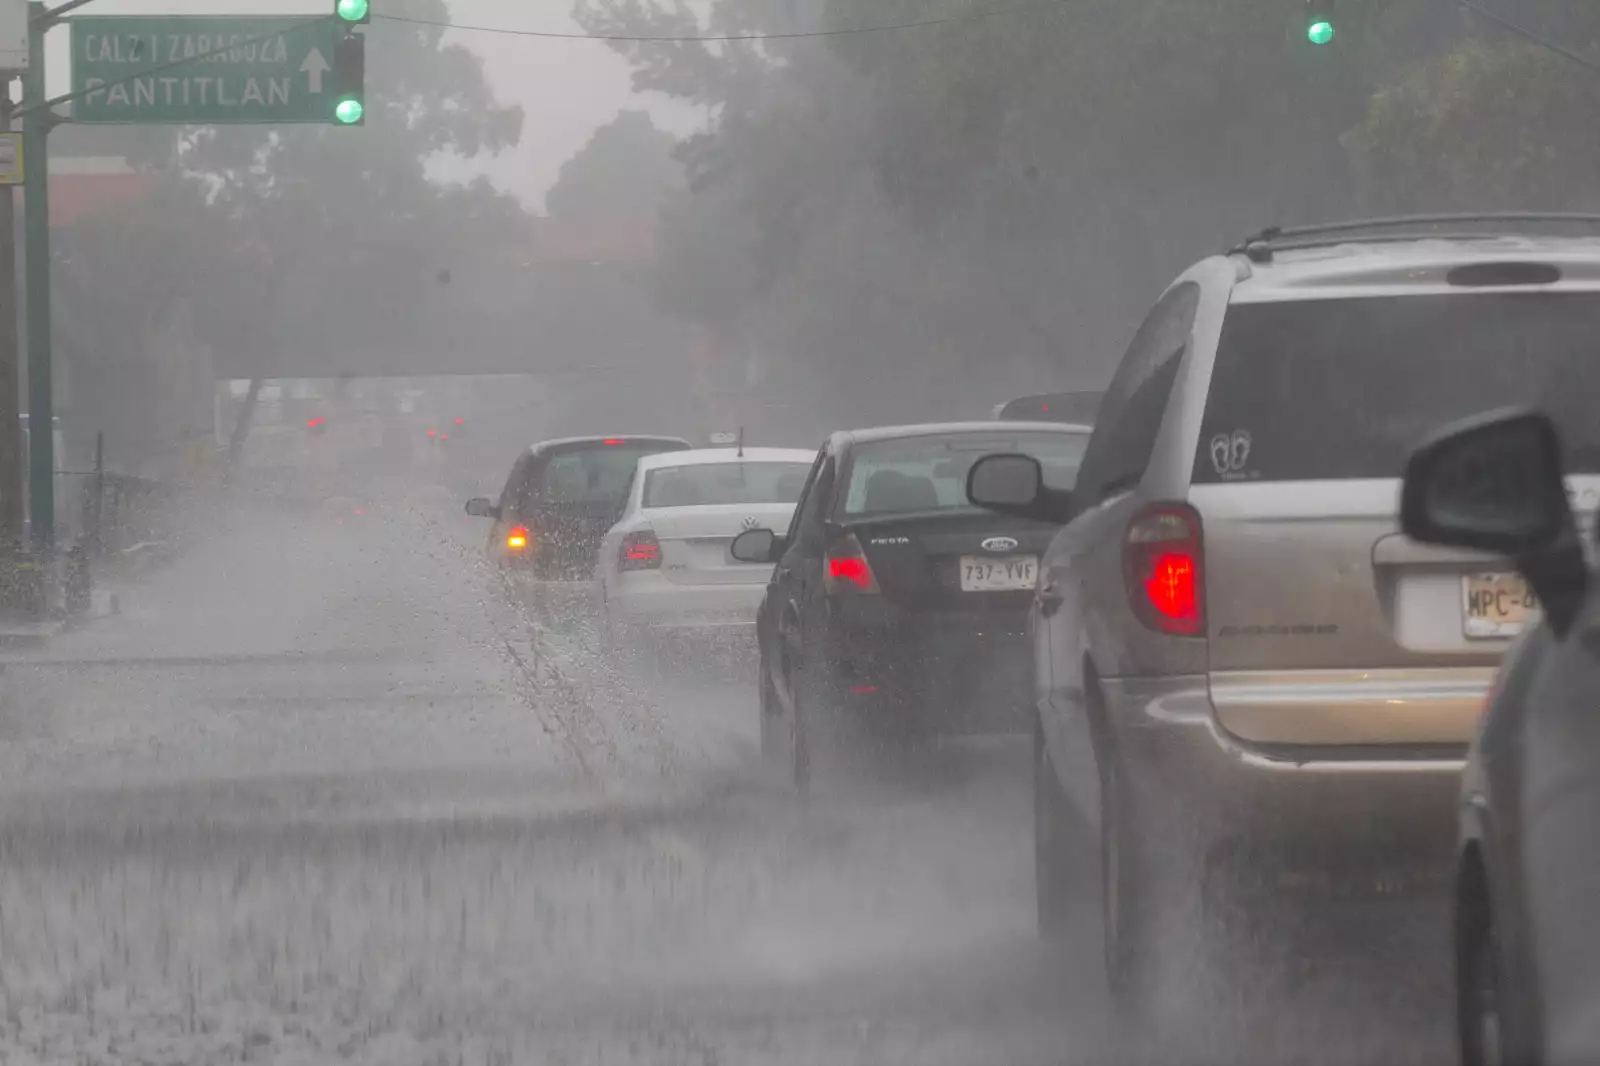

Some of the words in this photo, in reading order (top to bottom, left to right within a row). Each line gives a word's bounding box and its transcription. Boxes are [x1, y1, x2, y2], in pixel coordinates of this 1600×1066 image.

[168, 34, 288, 63] ZARAGOZA
[84, 76, 292, 107] PANTITLAN
[871, 536, 910, 545] FIESTA
[965, 564, 1033, 581] 737-YVF
